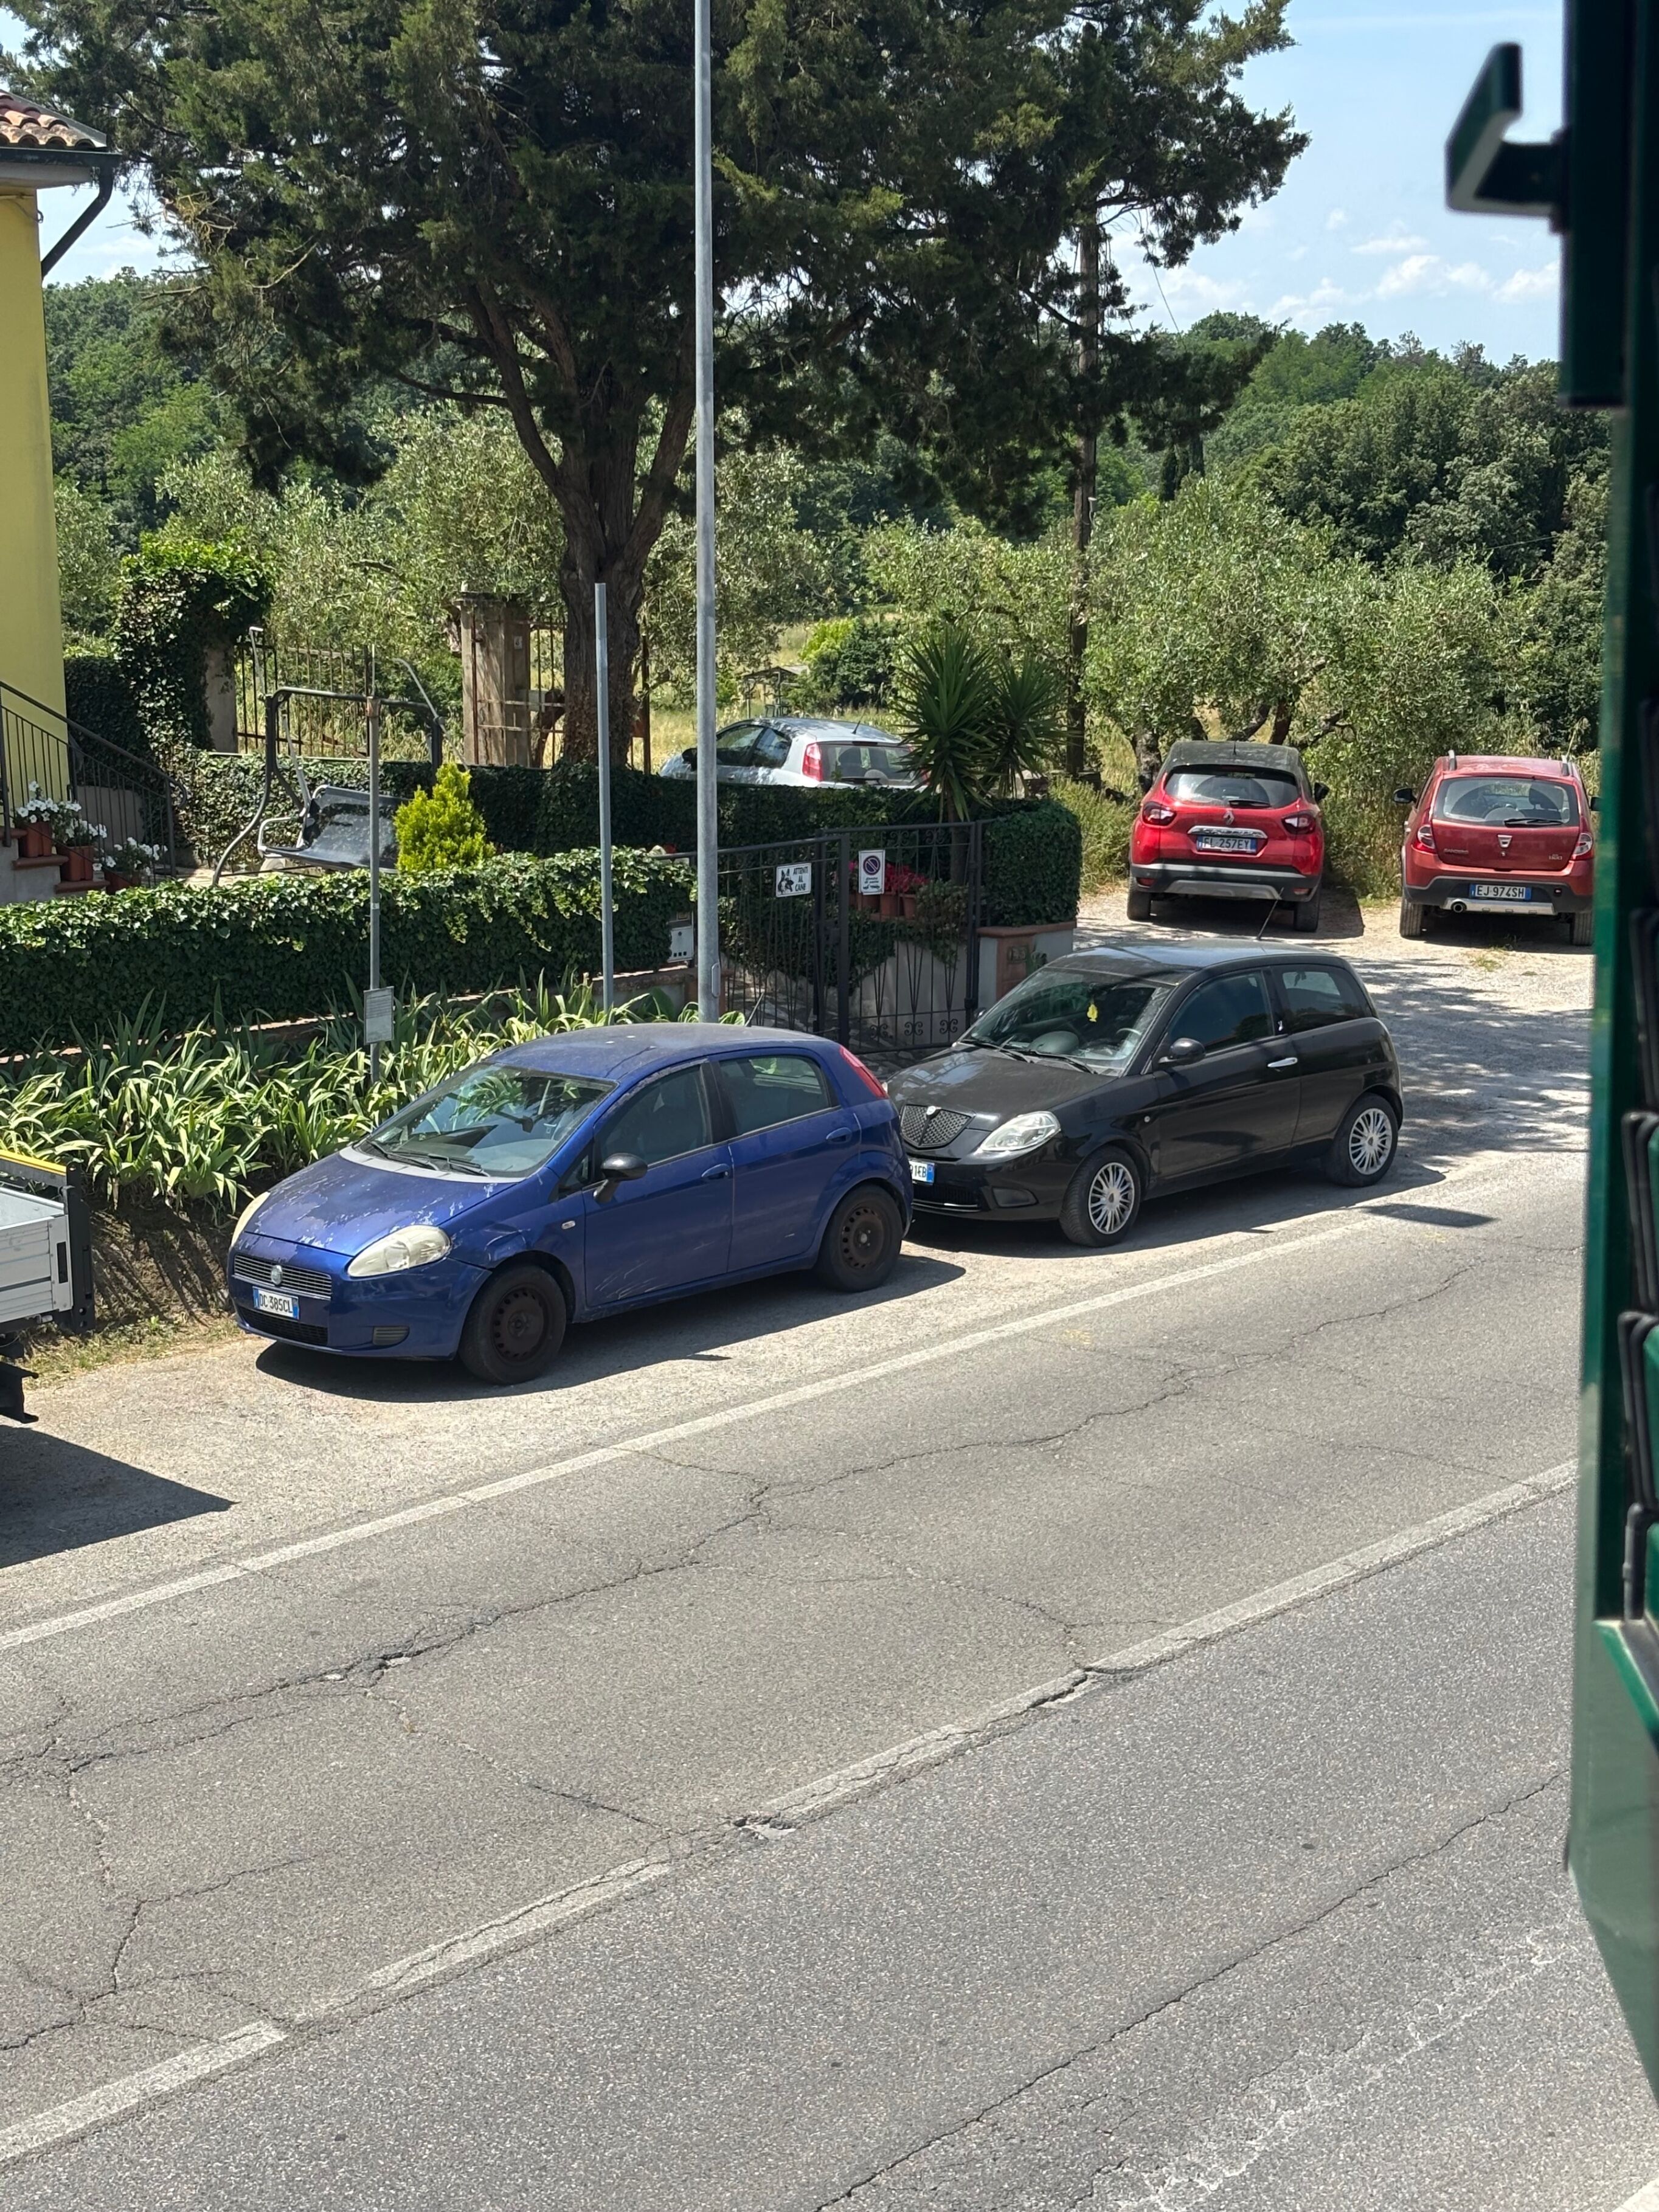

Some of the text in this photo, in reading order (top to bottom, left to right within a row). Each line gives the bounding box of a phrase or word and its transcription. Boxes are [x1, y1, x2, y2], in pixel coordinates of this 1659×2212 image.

[1219, 838, 1249, 849] 257EY
[793, 866, 808, 875] ATTENTI
[795, 883, 806, 892] CANE
[1477, 885, 1524, 897] EJ 974SH
[260, 1293, 293, 1313] DC 385CL
